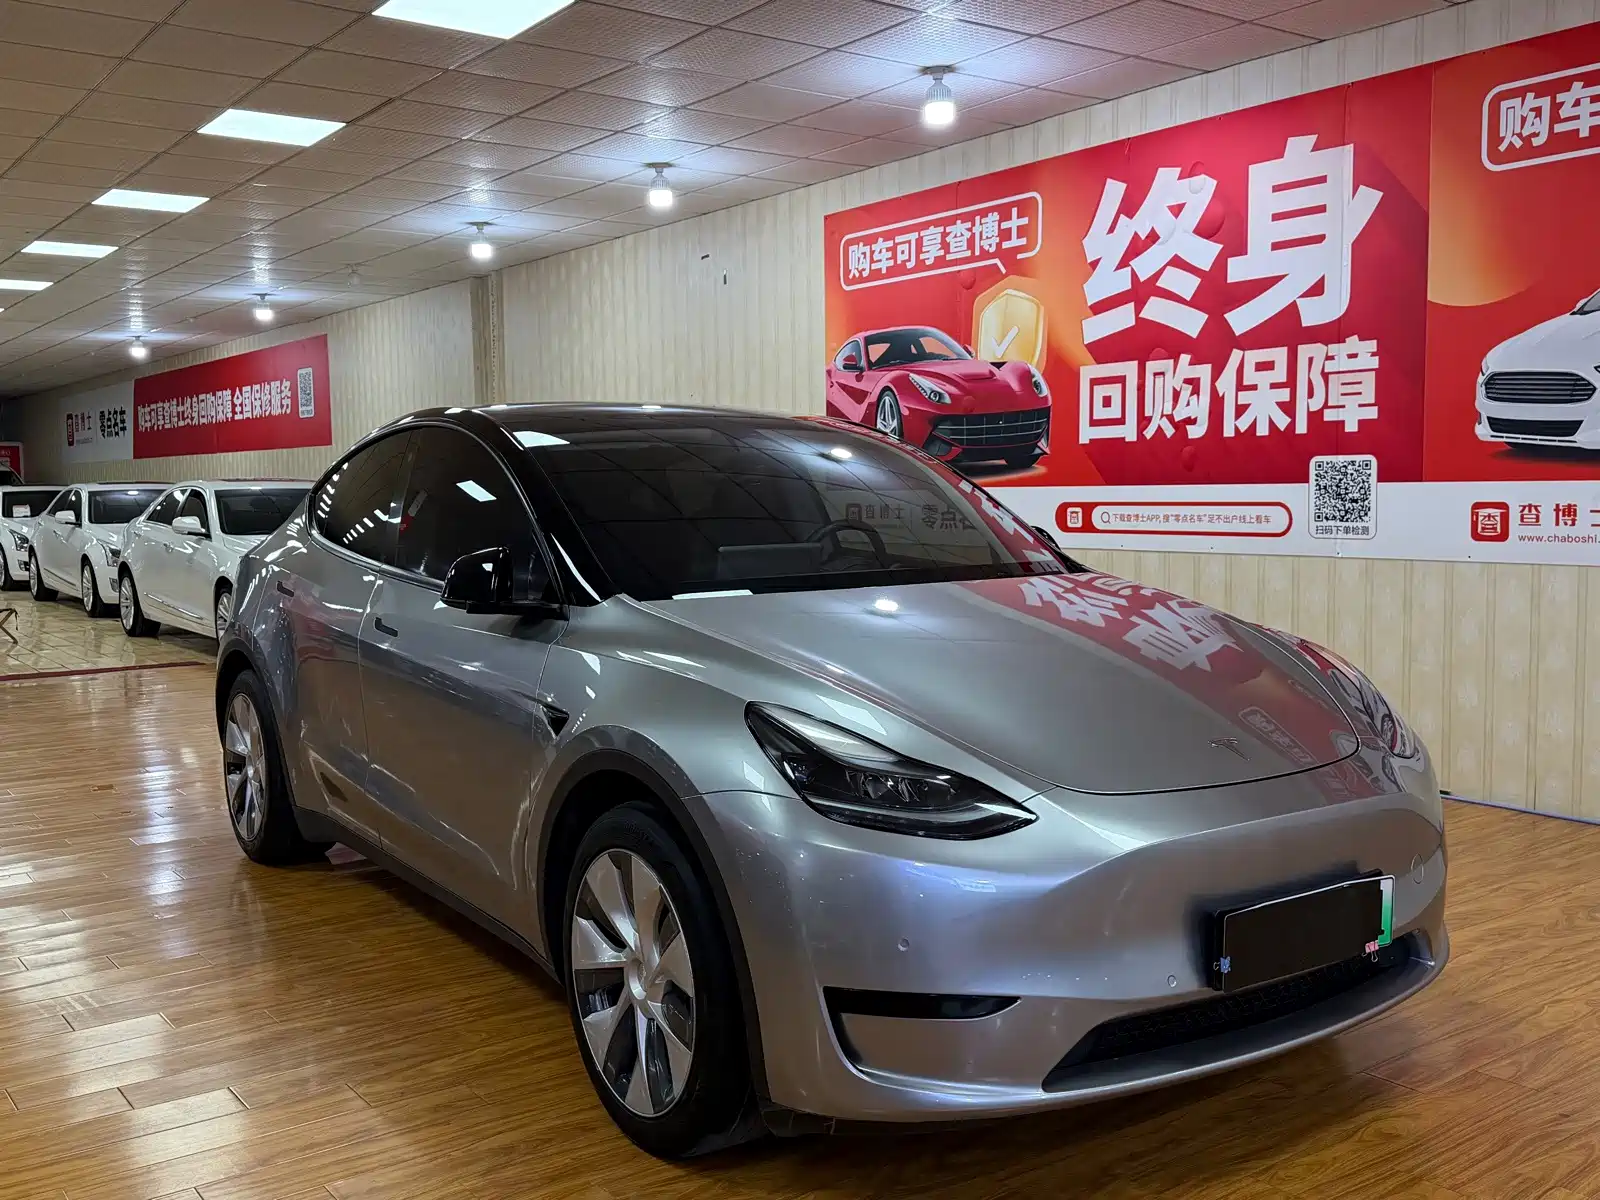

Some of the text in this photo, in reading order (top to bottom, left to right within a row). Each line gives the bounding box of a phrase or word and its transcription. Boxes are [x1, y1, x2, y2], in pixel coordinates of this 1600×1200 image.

[1498, 81, 1600, 152] 购车
[849, 207, 1029, 279] 购车可享查博士
[1082, 134, 1384, 346] 终身
[138, 379, 292, 432] 购车可享查博士终身回购保障 全国保修服务
[1078, 335, 1380, 445] 回购保障
[1315, 525, 1370, 536] 扫码下单检测
